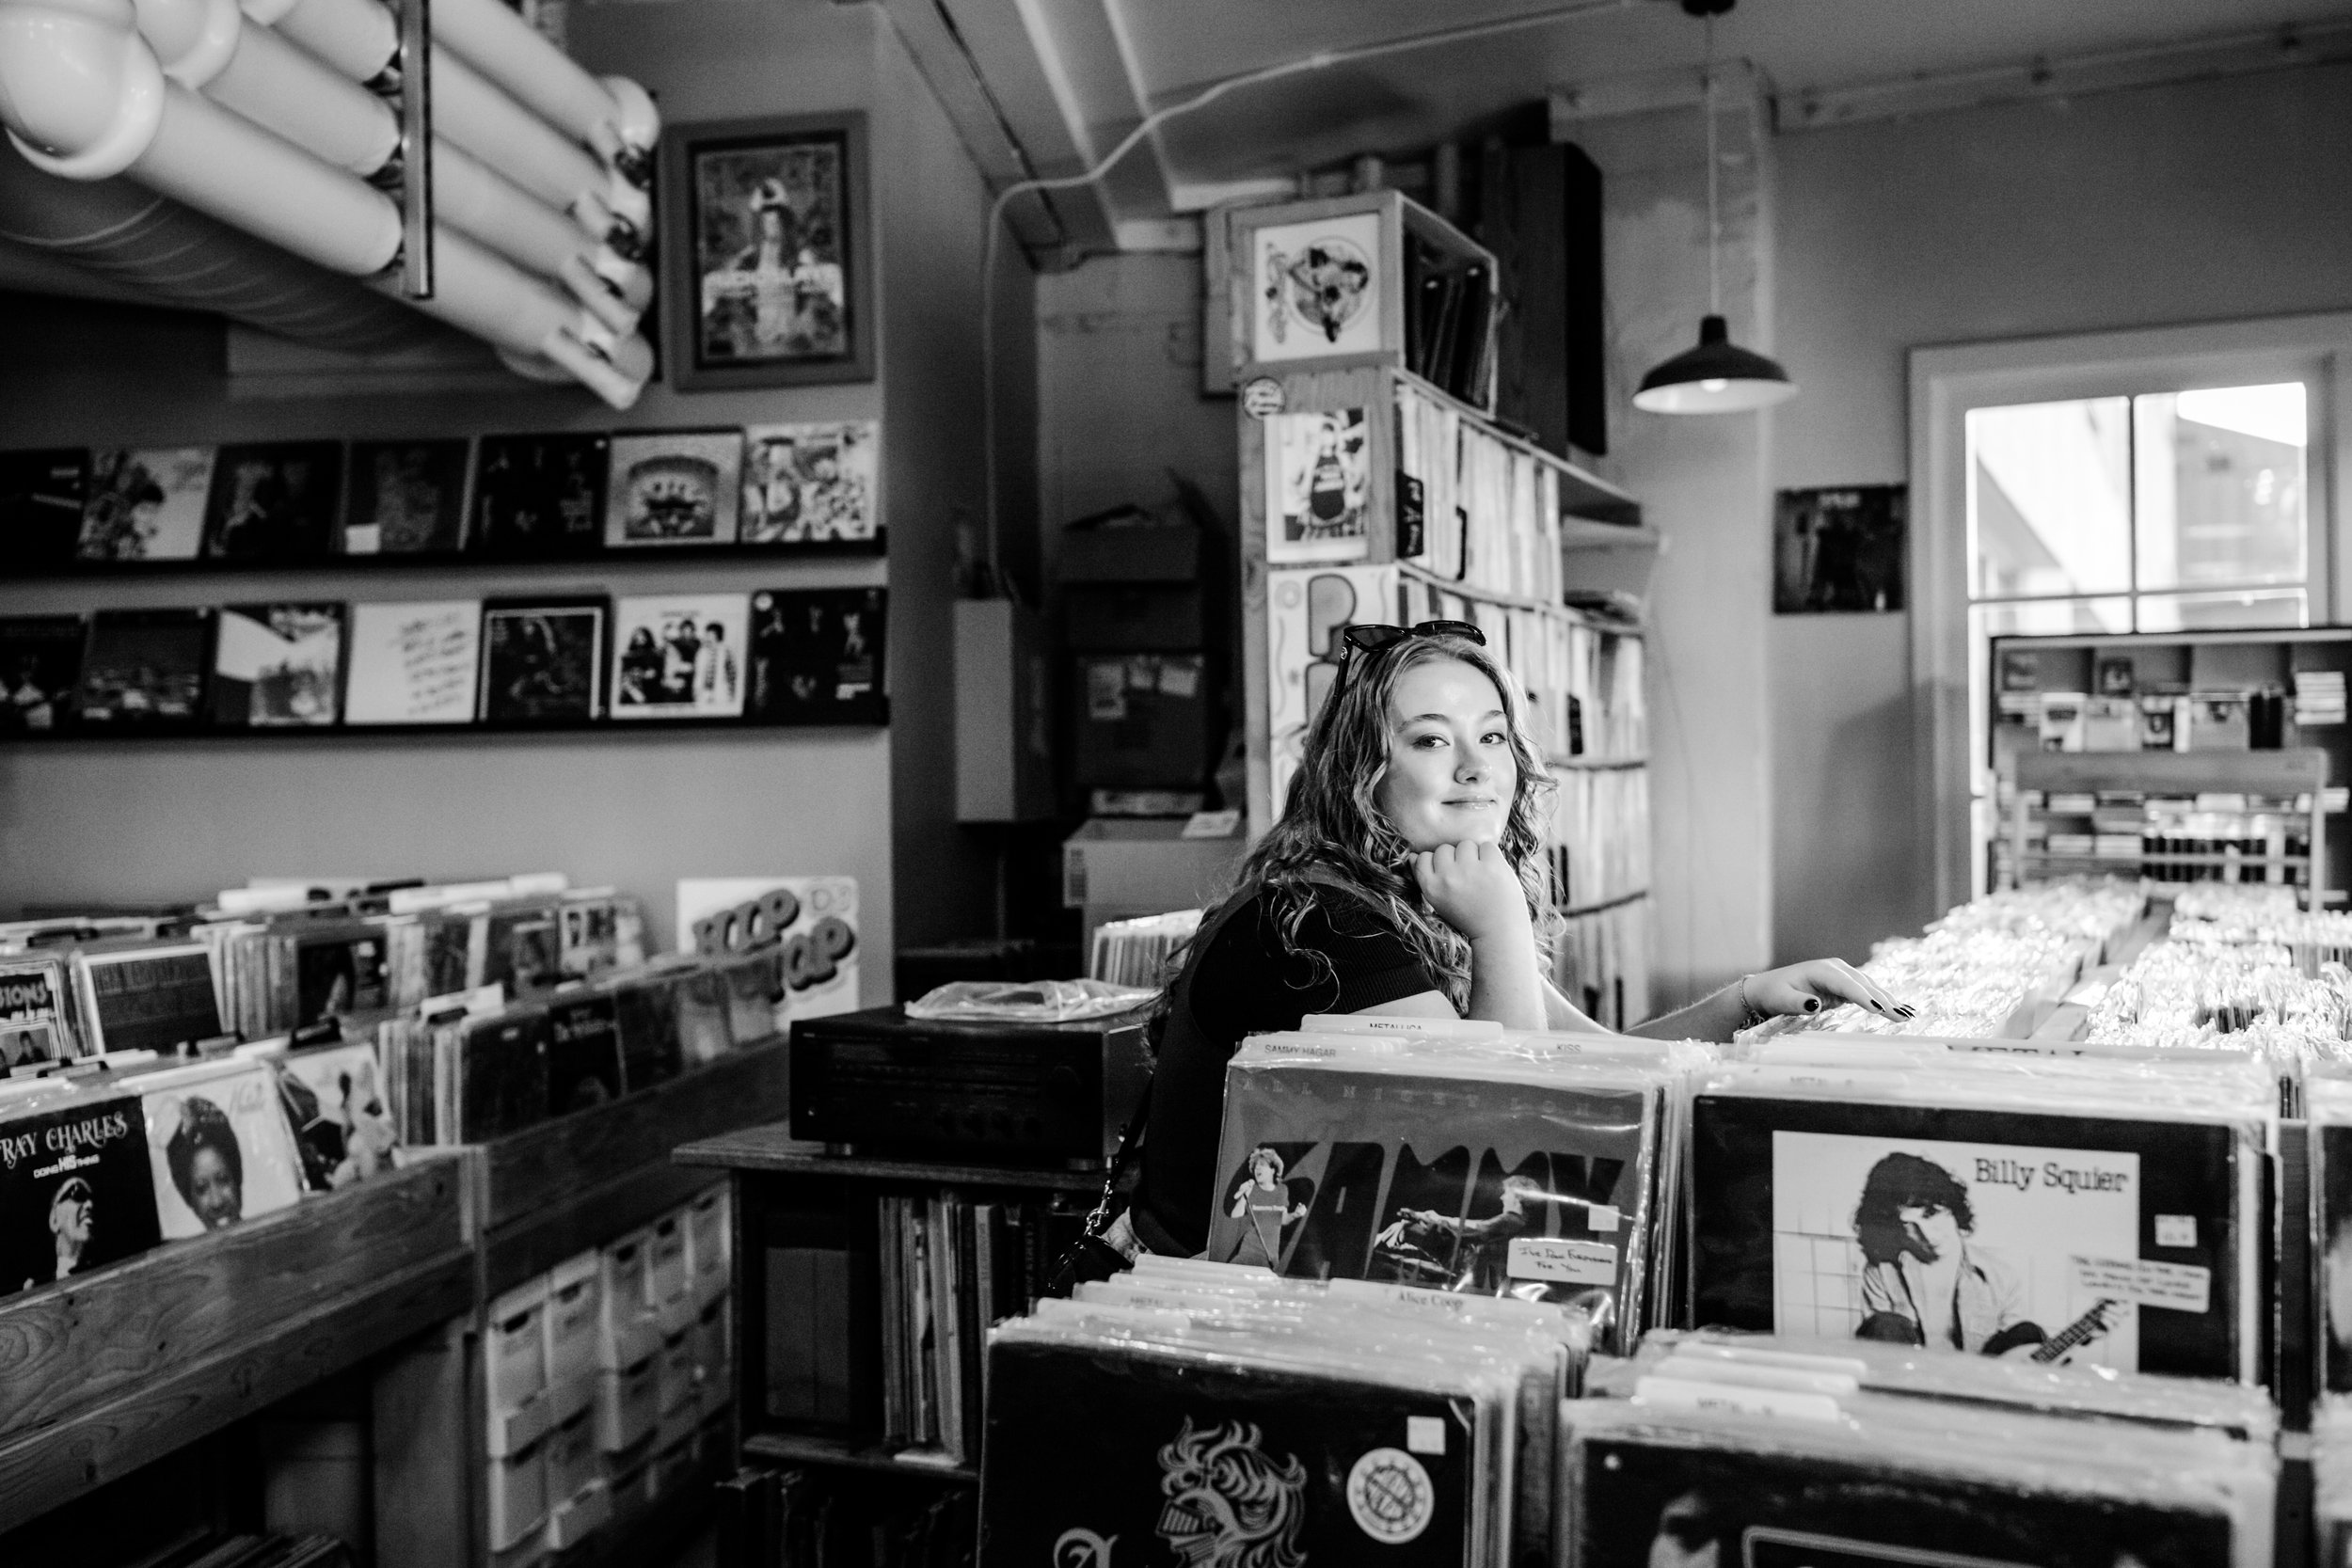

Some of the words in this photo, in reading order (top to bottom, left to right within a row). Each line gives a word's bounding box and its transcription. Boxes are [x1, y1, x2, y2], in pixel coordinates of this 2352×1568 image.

[1264, 1044, 1300, 1054] SAMMY
[1302, 1046, 1337, 1057] HAGAR
[1556, 1043, 1581, 1053] KISS
[0, 1132, 38, 1170] RAY
[45, 1111, 128, 1155] CHARLES
[57, 1154, 79, 1172] HIS
[1974, 1157, 2036, 1192] Billy
[2042, 1162, 2129, 1195] Squier
